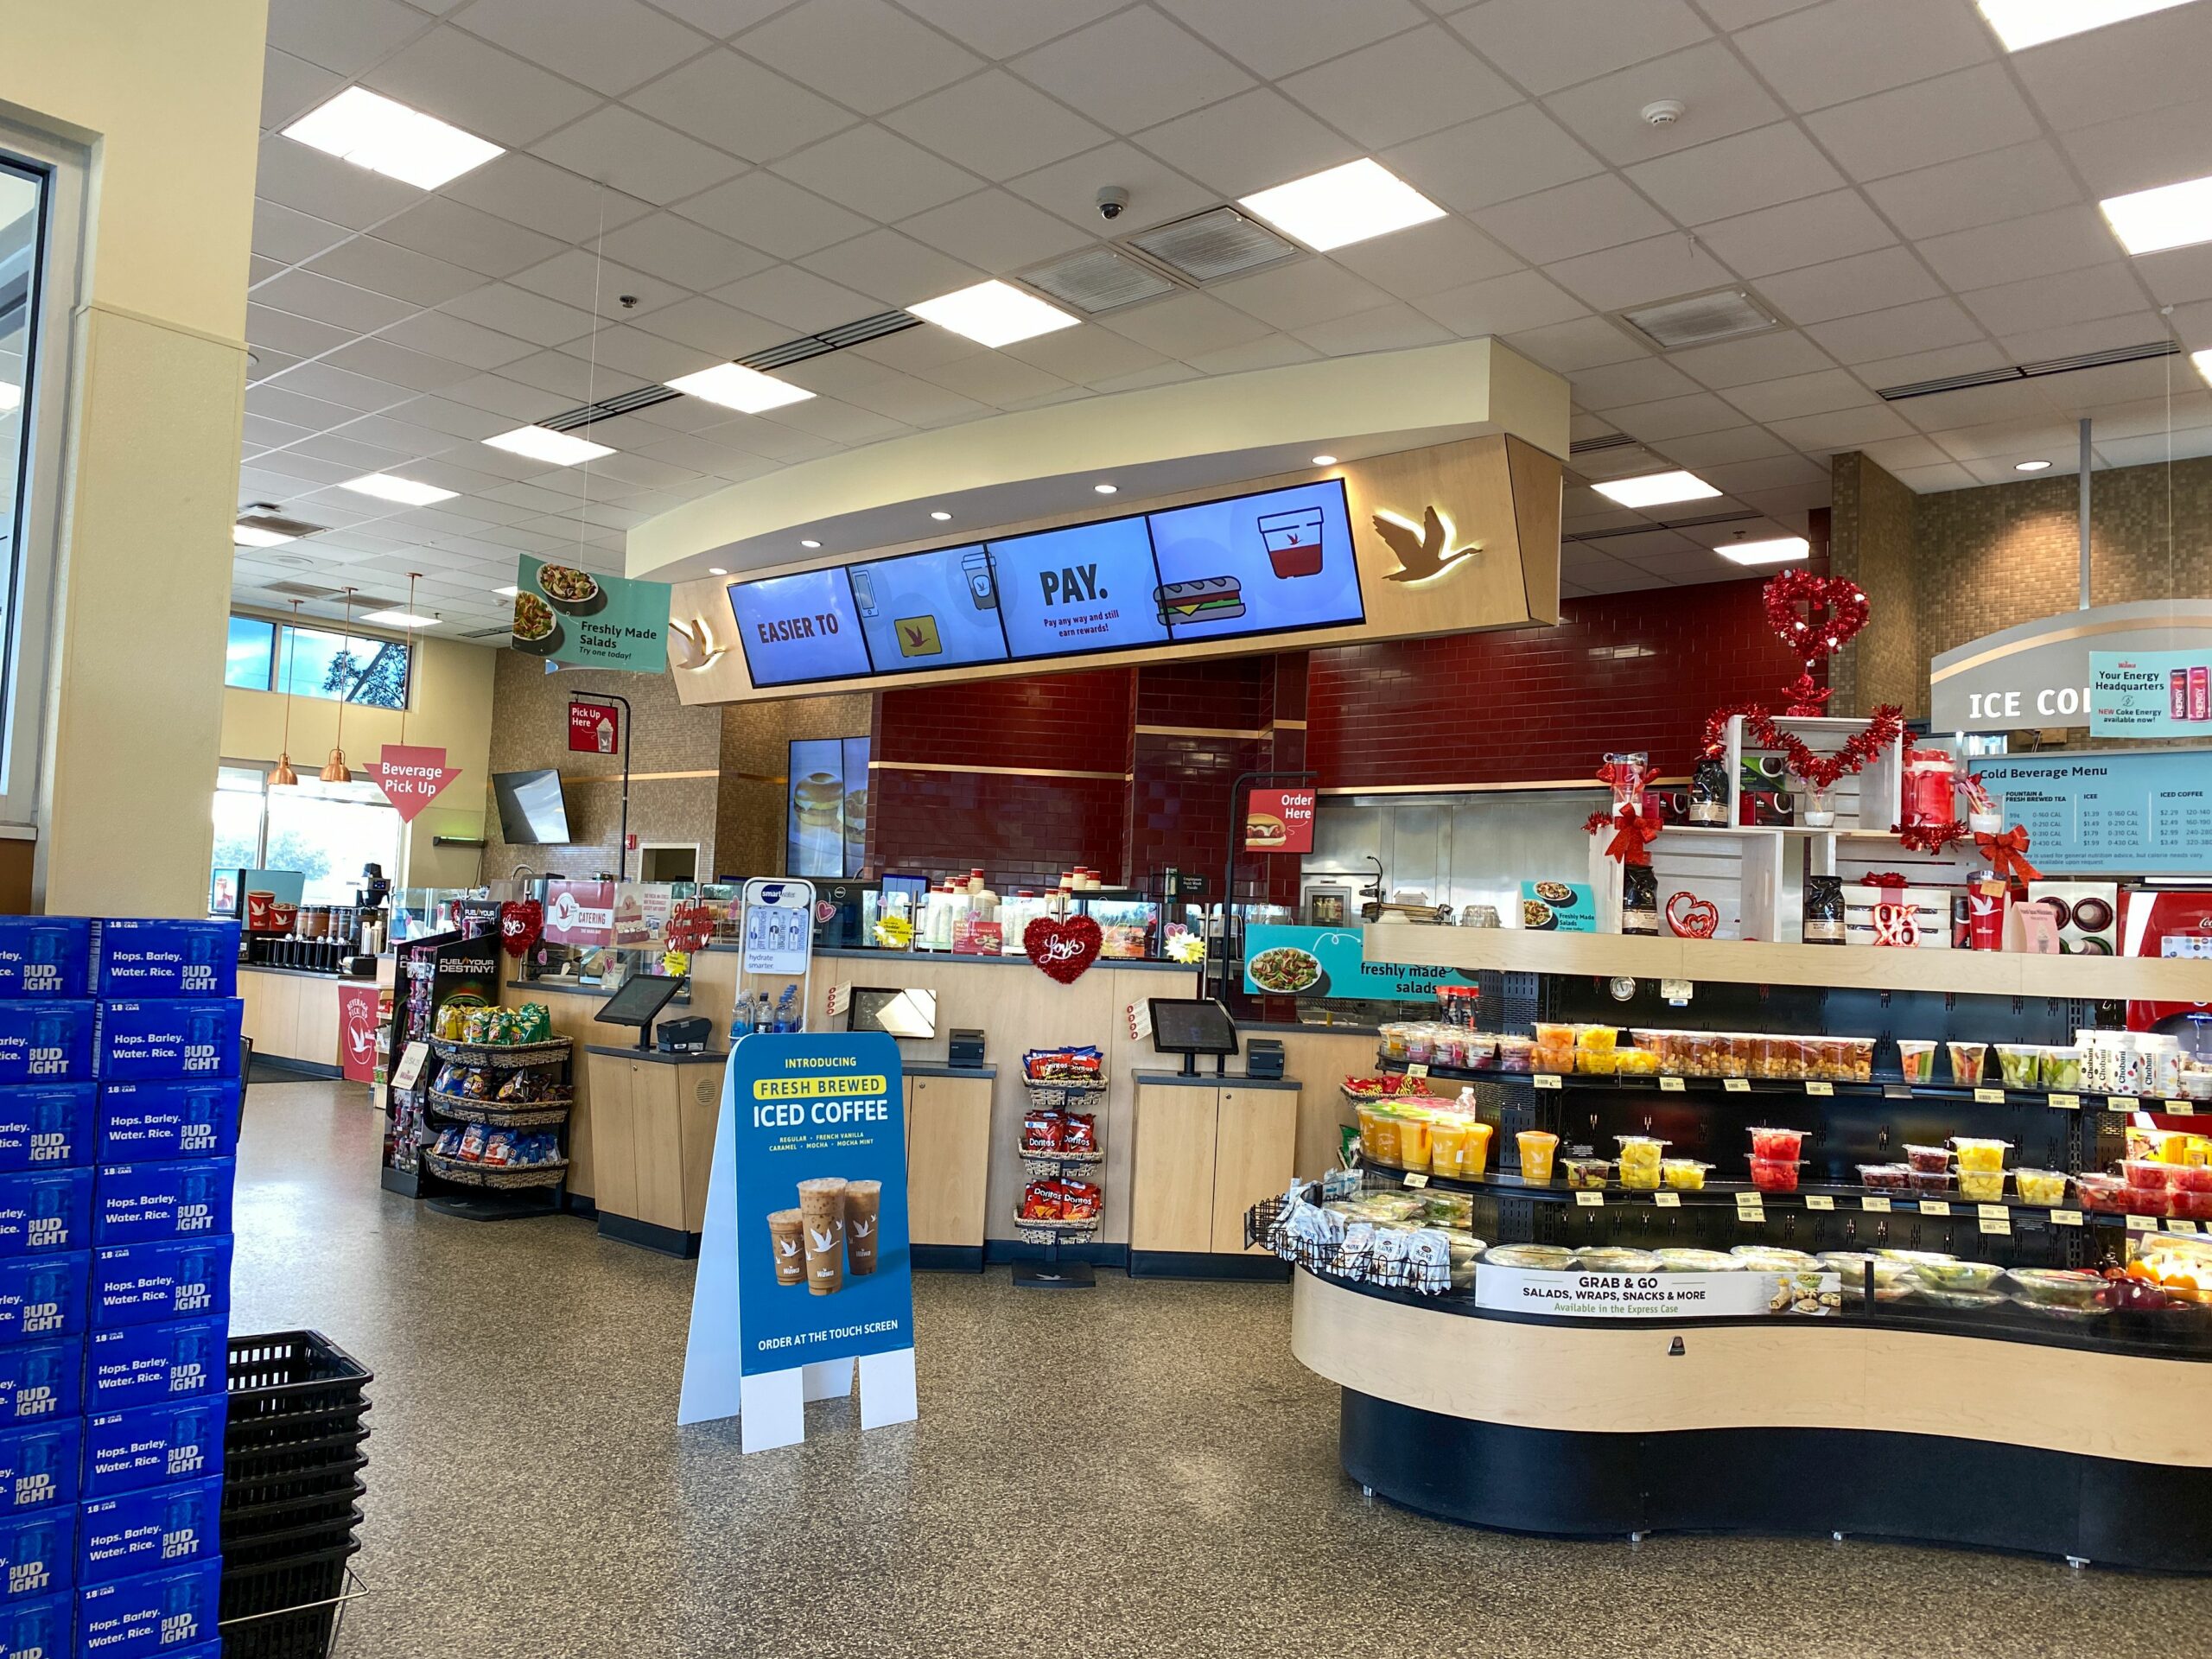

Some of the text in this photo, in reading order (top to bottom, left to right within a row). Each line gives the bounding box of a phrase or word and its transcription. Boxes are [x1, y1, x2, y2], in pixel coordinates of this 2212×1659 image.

[1039, 563, 1108, 606] PAY.
[1044, 619, 1057, 628] Pay
[1090, 612, 1103, 621] and
[1104, 610, 1119, 620] still
[582, 620, 657, 639] Freshly Made
[758, 613, 838, 644] EASIER TO
[1058, 623, 1109, 638] earn rewards!
[580, 634, 617, 648] Salads
[580, 646, 591, 655] Try
[607, 652, 632, 660] today!
[2099, 671, 2159, 682] Your Energy
[2095, 682, 2164, 692] Headquarters
[1969, 692, 2021, 718] ICE
[2176, 689, 2184, 717] ENERGY
[2196, 689, 2205, 718] ENERGY
[572, 708, 601, 720] Pick Up
[2115, 708, 2134, 716] Coke
[2134, 709, 2163, 717] Energy
[572, 717, 590, 727] Here
[382, 762, 442, 780] Beverage
[1980, 766, 2107, 779] Cold Beverage Menu
[385, 779, 435, 797] Pick Up
[1281, 794, 1313, 805] Order
[1286, 808, 1311, 818] Here
[578, 912, 606, 925] CATERING
[1559, 912, 1579, 921] Freshly
[109, 920, 123, 929] 18
[113, 951, 182, 963] Hops. Barley.
[439, 957, 467, 966] FUEL
[111, 968, 175, 976] Water. Rice.
[182, 965, 212, 977] BUD
[439, 964, 493, 973] DESTINY!
[1361, 963, 1446, 978] freshly made
[1396, 981, 1436, 994] salads
[115, 1033, 184, 1045] Hops. Barley.
[112, 1048, 177, 1058] Water. Rice.
[184, 1045, 214, 1058] BUD
[785, 1057, 856, 1068] INTRODUCING
[2118, 1051, 2126, 1084] Chobani
[760, 1077, 880, 1095] FRESH BREWED
[753, 1099, 887, 1128] ICED COFFEE
[779, 1135, 808, 1143] REGULAR
[1029, 1138, 1055, 1147] Doritos
[768, 1143, 798, 1152] CARAMEL
[1034, 1188, 1062, 1201] Doritos
[1065, 1194, 1092, 1205] Doritos
[107, 1194, 176, 1209] Hops. Barley.
[105, 1211, 170, 1223] Water. Rice.
[177, 1205, 207, 1218] BUD
[1579, 1276, 1657, 1288] GRAB & GO
[1523, 1287, 1706, 1301] SALADS, WRAPS, SNACKS & MORE
[1554, 1303, 1678, 1315] Available in the Express Case
[759, 1319, 898, 1351] ORDER AT THE TOUCH SCREEN
[99, 1358, 168, 1375] Hops. Barley.
[170, 1363, 200, 1379] BUD
[99, 1373, 162, 1389] Water. Rice.
[91, 1525, 162, 1547] Hops. Barley.
[162, 1529, 194, 1546] BUD
[90, 1541, 155, 1560] Water. Rice.
